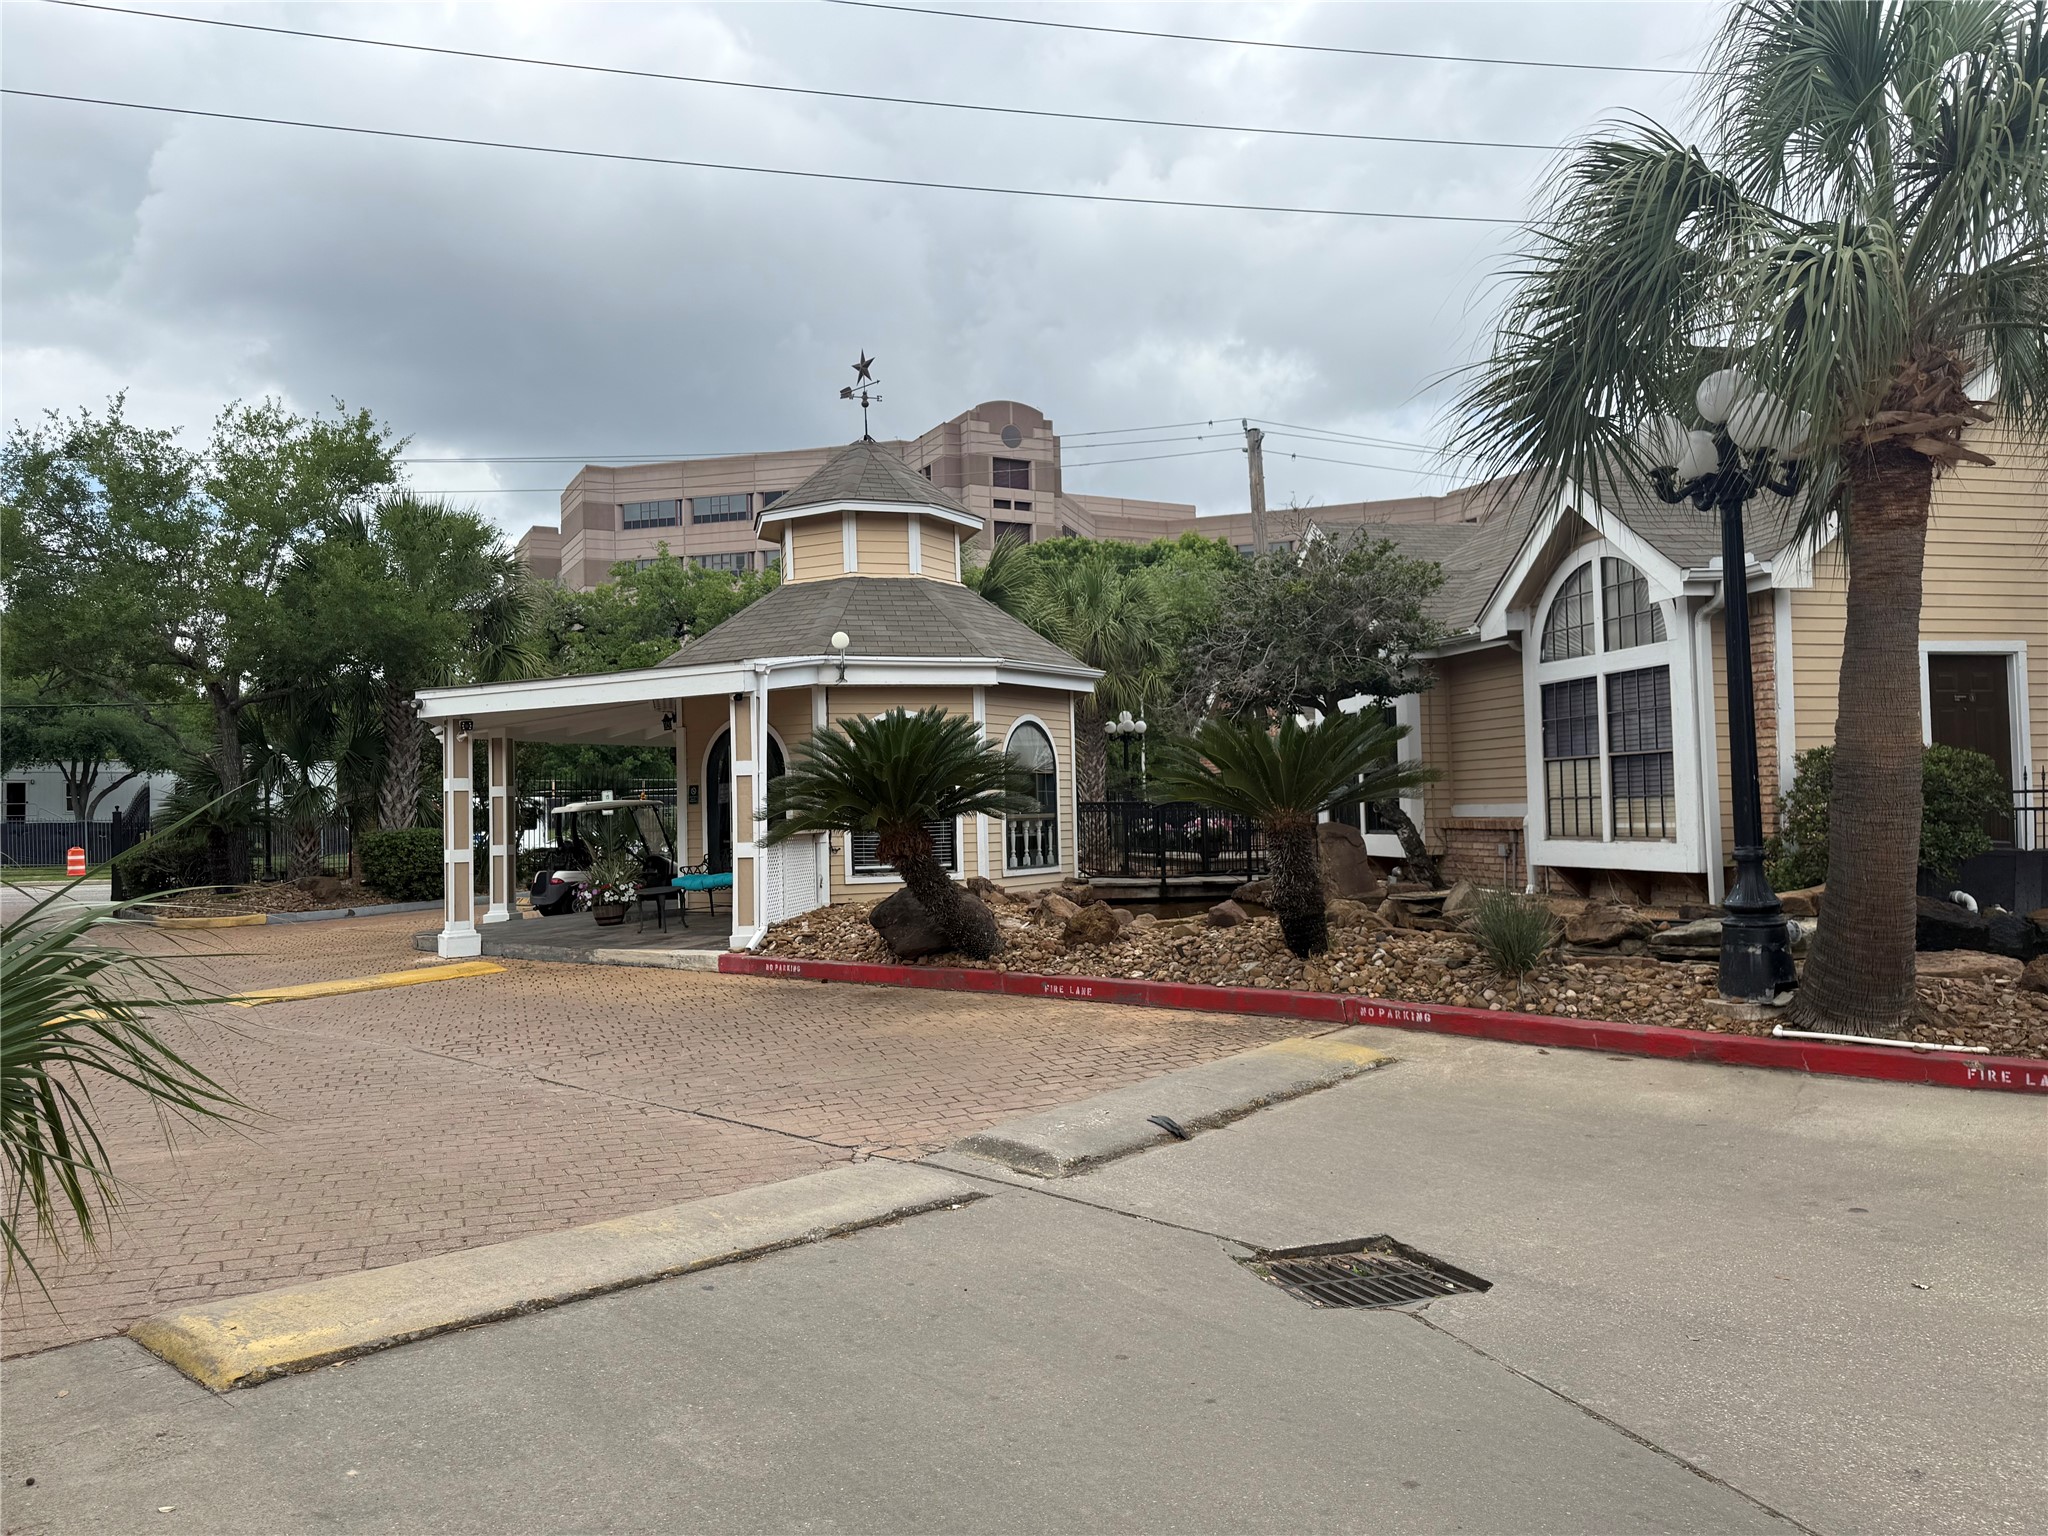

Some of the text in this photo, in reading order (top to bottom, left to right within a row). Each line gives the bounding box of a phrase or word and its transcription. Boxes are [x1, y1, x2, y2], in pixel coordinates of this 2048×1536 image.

[765, 963, 801, 972] NO PARKING
[1044, 984, 1092, 996] FIRE LANE
[1360, 1007, 1431, 1023] NO PARKING
[1967, 1068, 2012, 1084] FIRE
